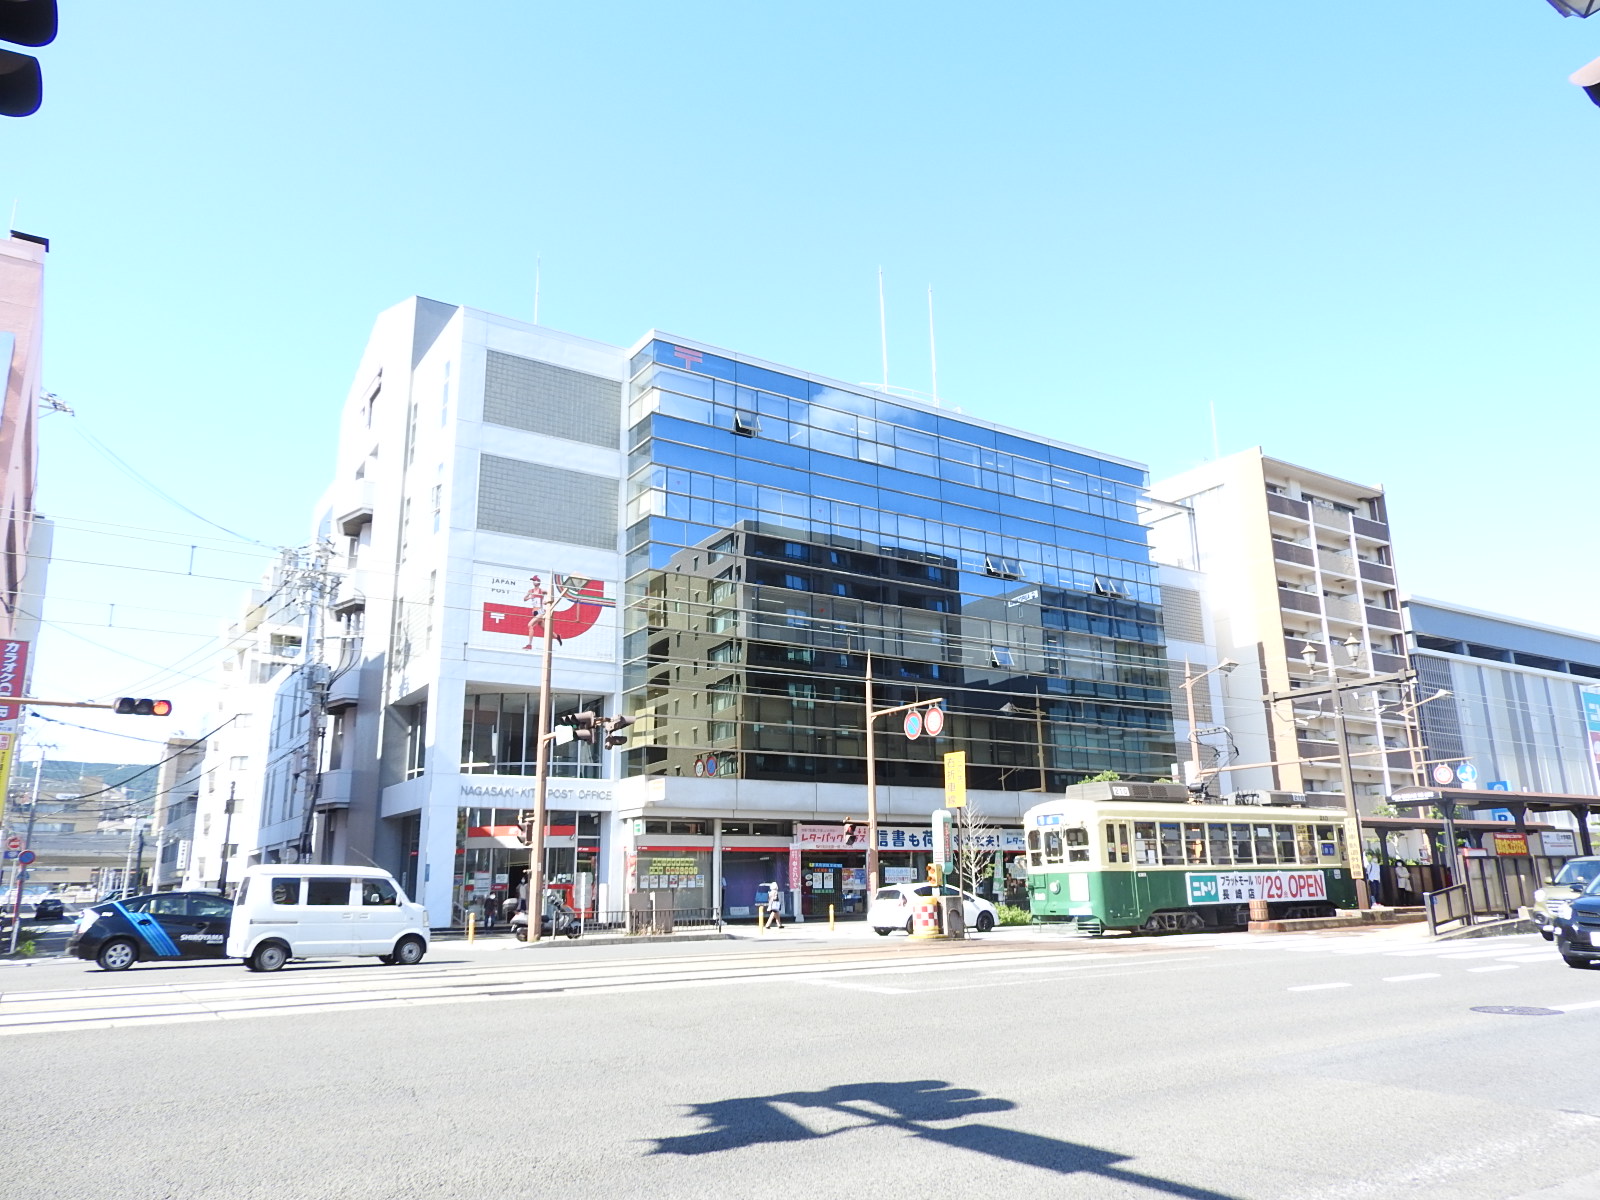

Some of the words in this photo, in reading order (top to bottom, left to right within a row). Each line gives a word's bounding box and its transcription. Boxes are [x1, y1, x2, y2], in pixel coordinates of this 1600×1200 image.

[491, 578, 516, 586] JAPAN
[547, 788, 574, 799] POST
[578, 789, 612, 800] OFFICE
[1114, 787, 1128, 795] 210
[1220, 875, 1253, 886] フラットモール
[1288, 874, 1325, 898] OPEN
[1192, 881, 1216, 896] ニトリ
